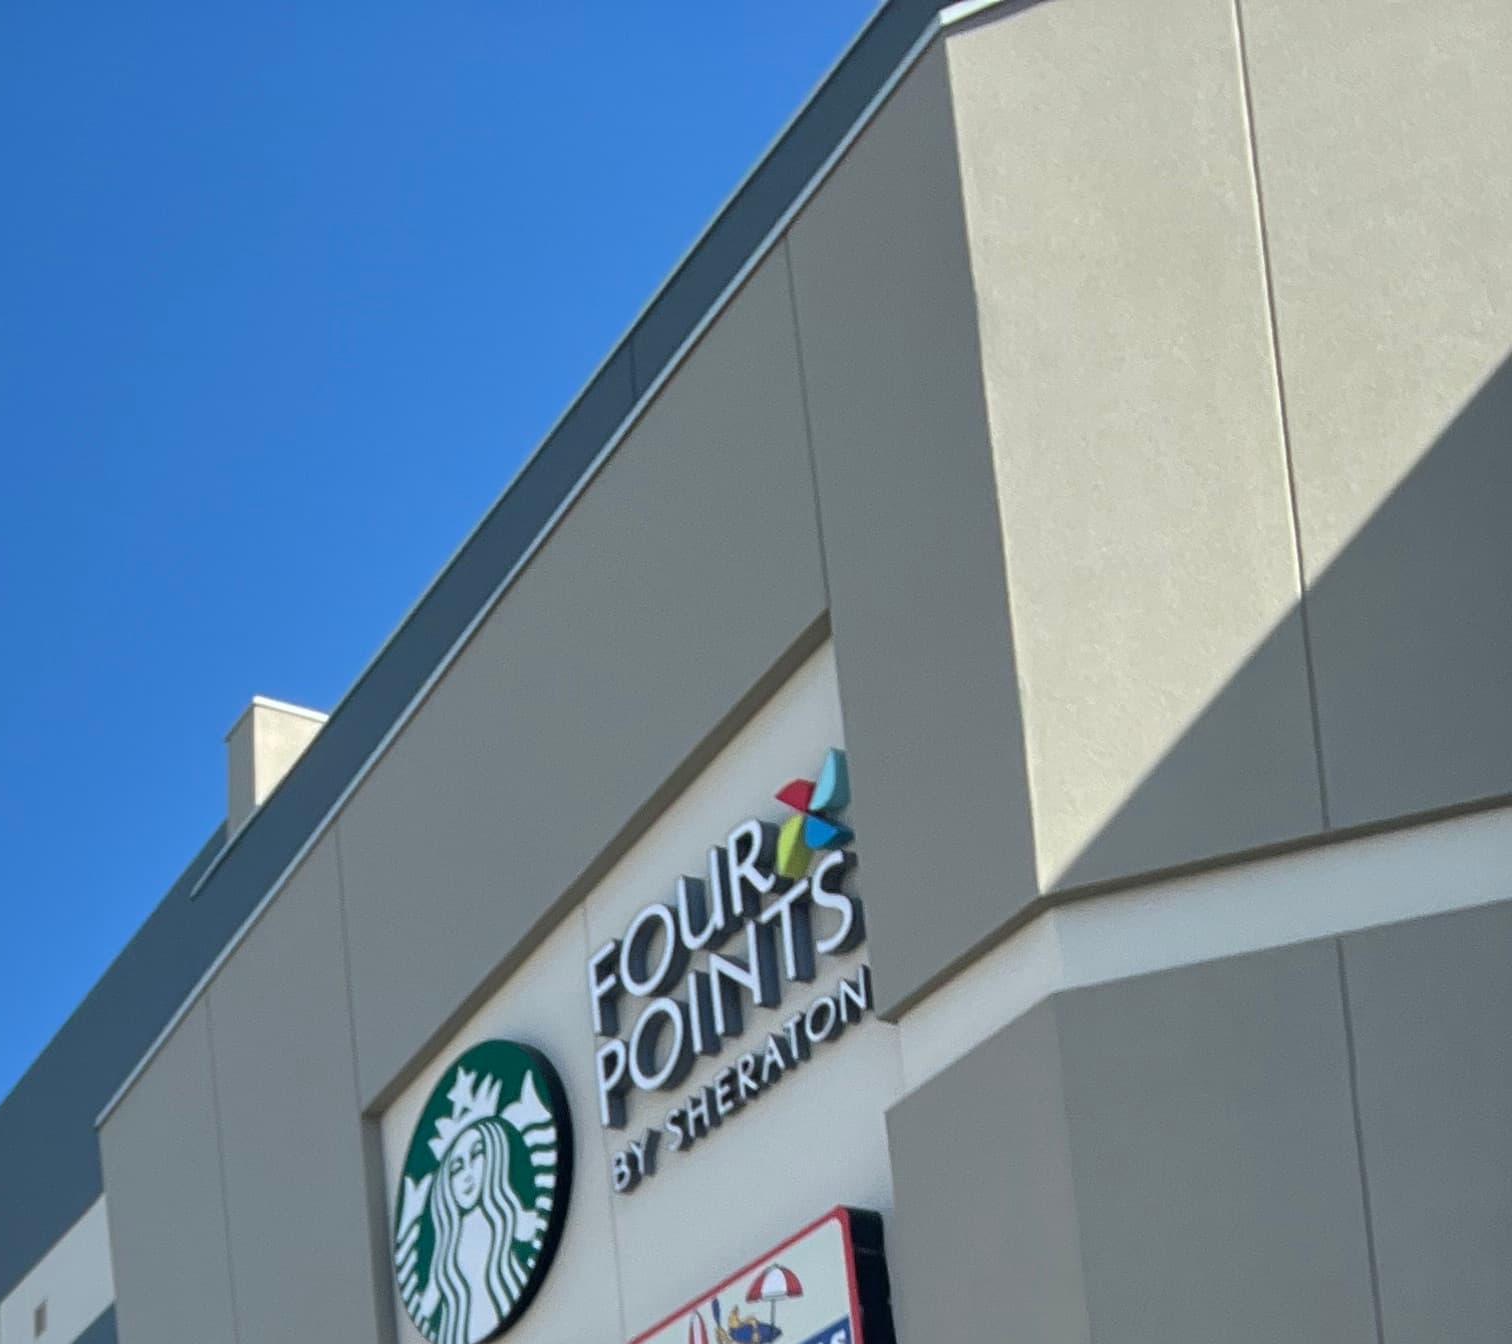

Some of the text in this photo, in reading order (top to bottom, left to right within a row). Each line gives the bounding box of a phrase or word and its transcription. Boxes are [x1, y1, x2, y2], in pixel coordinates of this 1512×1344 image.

[587, 818, 778, 1035] FOUR
[595, 850, 862, 1127] POINTS
[611, 964, 873, 1192] BY SHERATON
